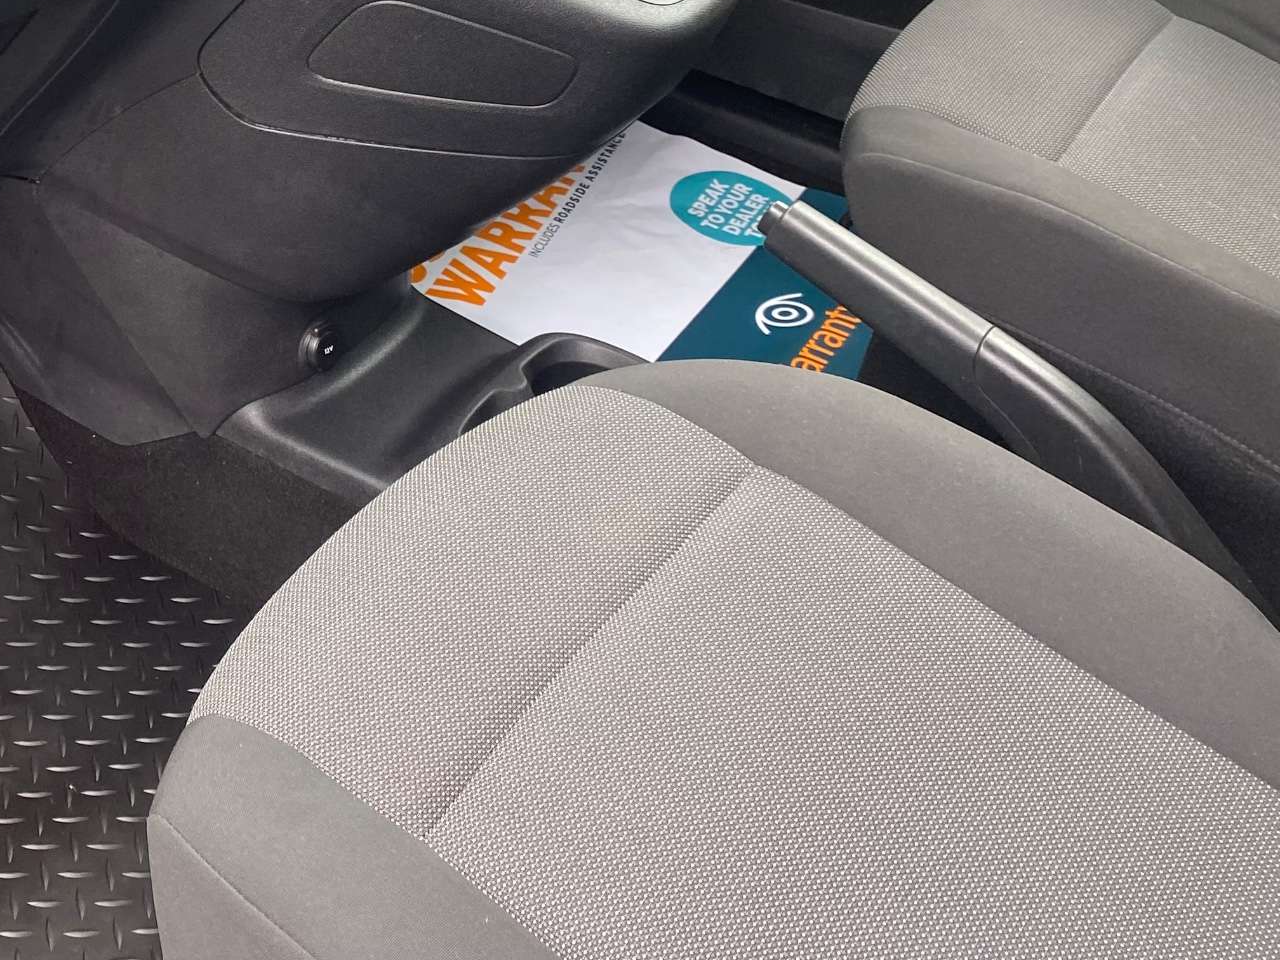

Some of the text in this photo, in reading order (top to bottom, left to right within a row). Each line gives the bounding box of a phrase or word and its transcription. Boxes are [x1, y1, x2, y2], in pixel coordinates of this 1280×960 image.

[528, 221, 561, 258] INCLUDES
[553, 182, 591, 224] ROADSIDE
[687, 178, 730, 218] SPEAK
[700, 182, 753, 230] TO YOUR
[721, 192, 770, 236] DEALER
